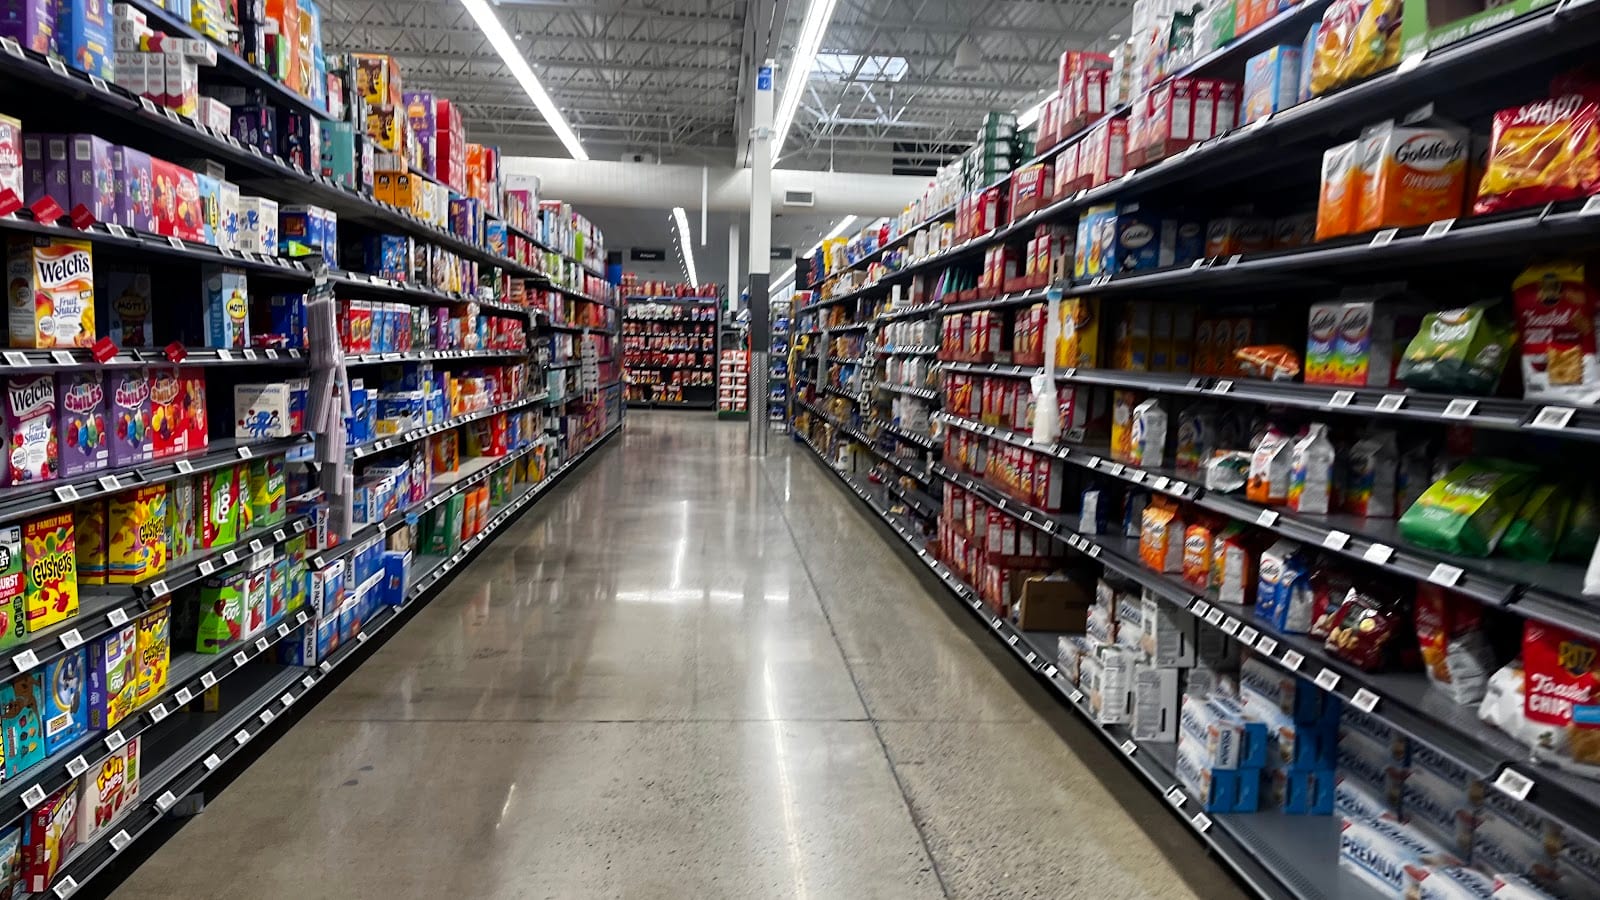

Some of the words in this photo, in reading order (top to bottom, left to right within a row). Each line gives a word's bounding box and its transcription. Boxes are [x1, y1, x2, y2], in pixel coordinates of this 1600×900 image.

[1395, 139, 1462, 165] Goldfish
[38, 253, 90, 283] Welch's
[54, 304, 81, 318] Snacks
[59, 296, 78, 307] Fruit
[11, 379, 53, 412] Welch's
[64, 384, 103, 411] SMILES
[116, 382, 149, 406] SMILES
[24, 429, 48, 445] Snacks
[28, 421, 44, 434] Fruit
[37, 518, 58, 530] FAMILY
[58, 513, 73, 525] PACK
[33, 552, 73, 588] Gushers
[1529, 694, 1573, 719] CHIPS
[1342, 834, 1404, 885] PREMIUM
